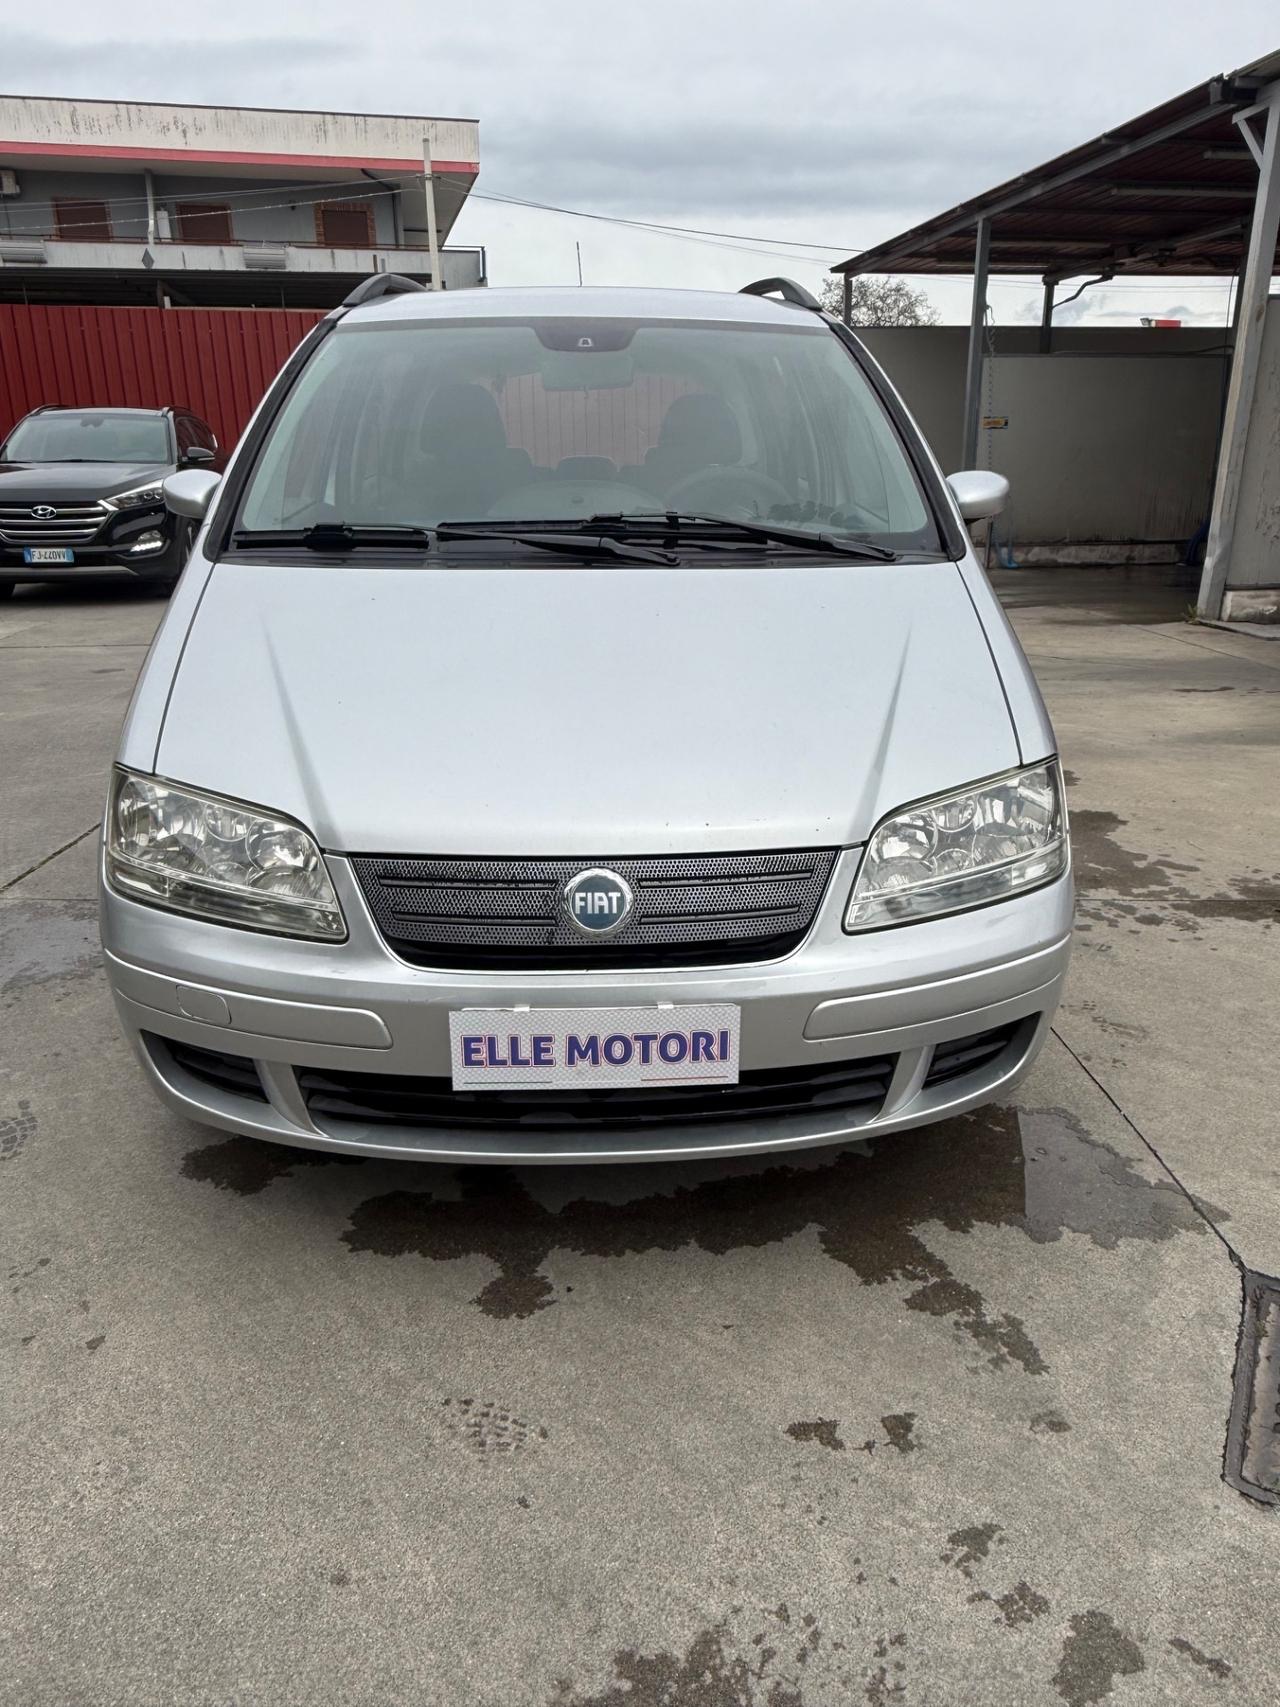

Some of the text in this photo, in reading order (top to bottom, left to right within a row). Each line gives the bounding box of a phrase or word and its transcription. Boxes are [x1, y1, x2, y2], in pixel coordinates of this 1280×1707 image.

[575, 892, 621, 914] FIAT
[462, 1029, 730, 1067] ELLE MOTORI
